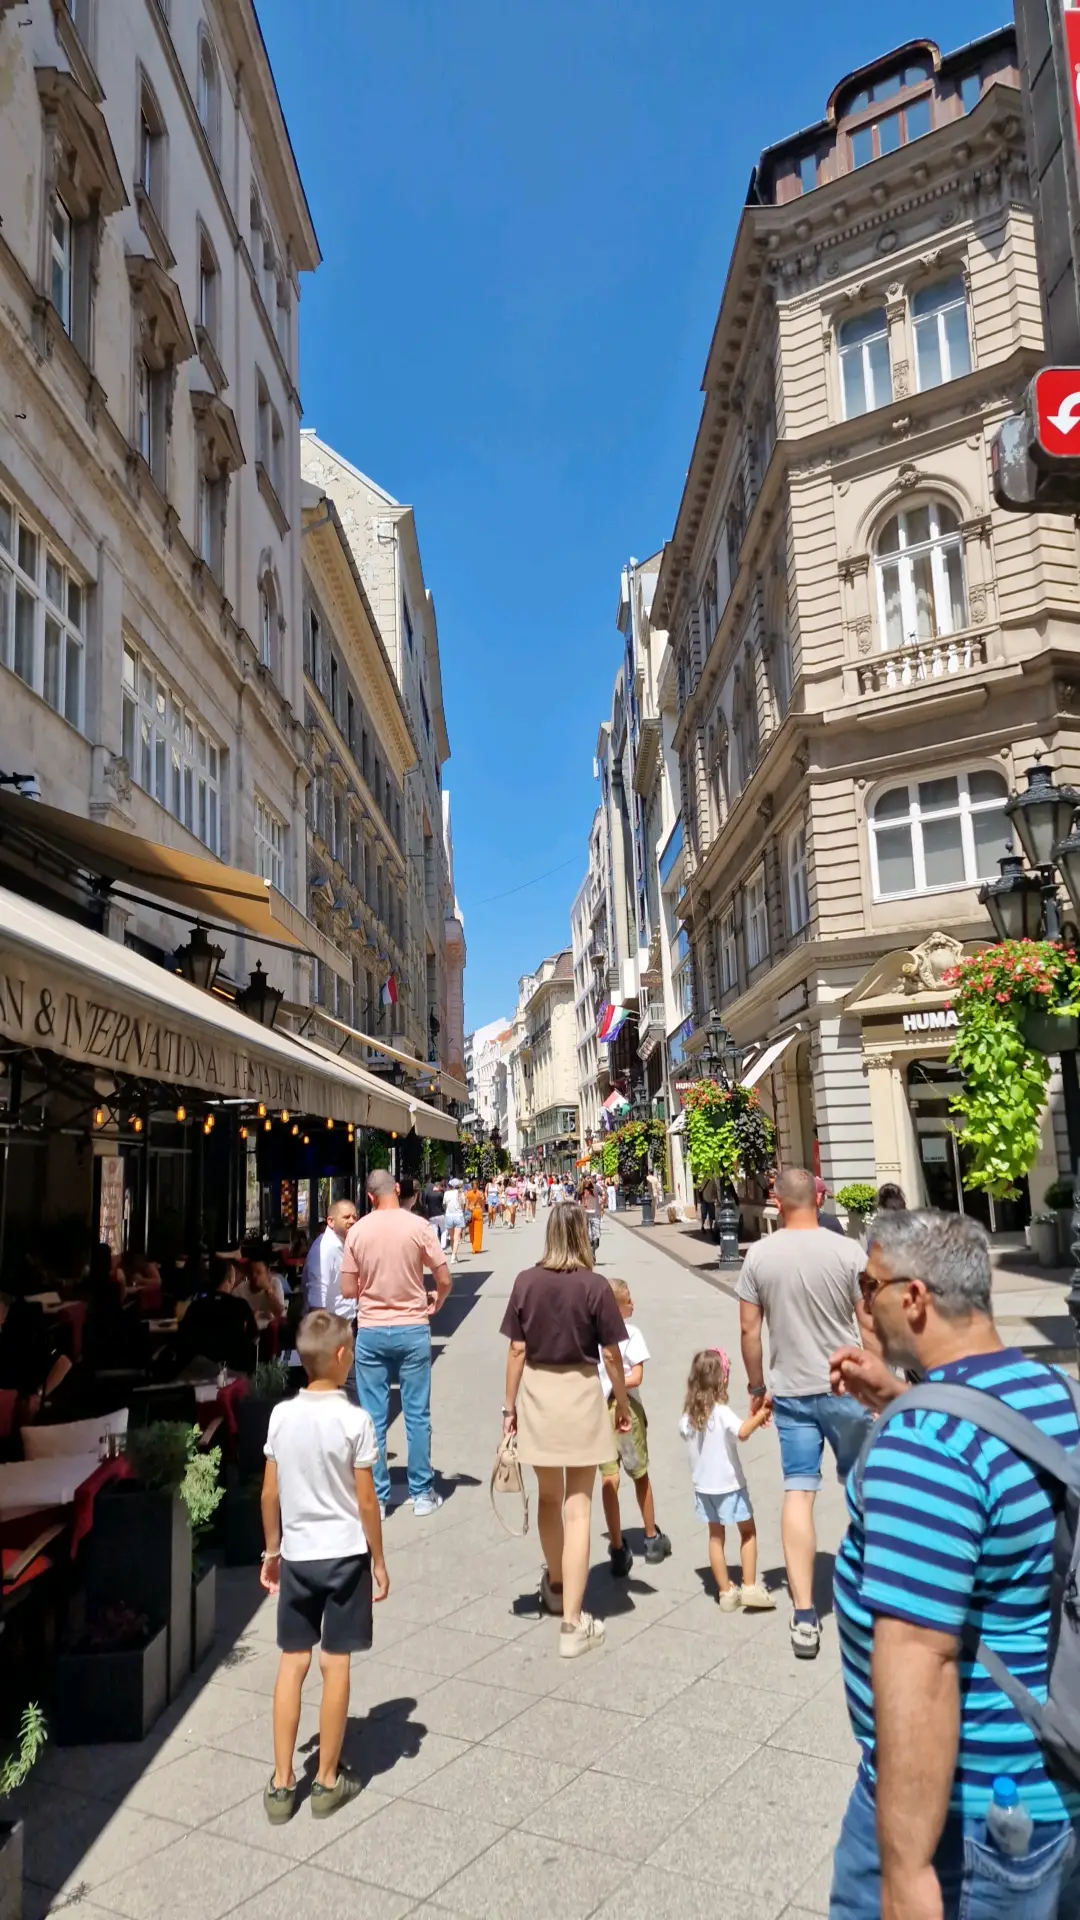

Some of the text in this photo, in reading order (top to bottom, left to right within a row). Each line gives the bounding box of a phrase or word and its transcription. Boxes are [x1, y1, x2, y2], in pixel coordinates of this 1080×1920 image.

[34, 988, 56, 1037] &
[62, 992, 225, 1087] INTERNATIONAL
[903, 1010, 963, 1031] HUMA
